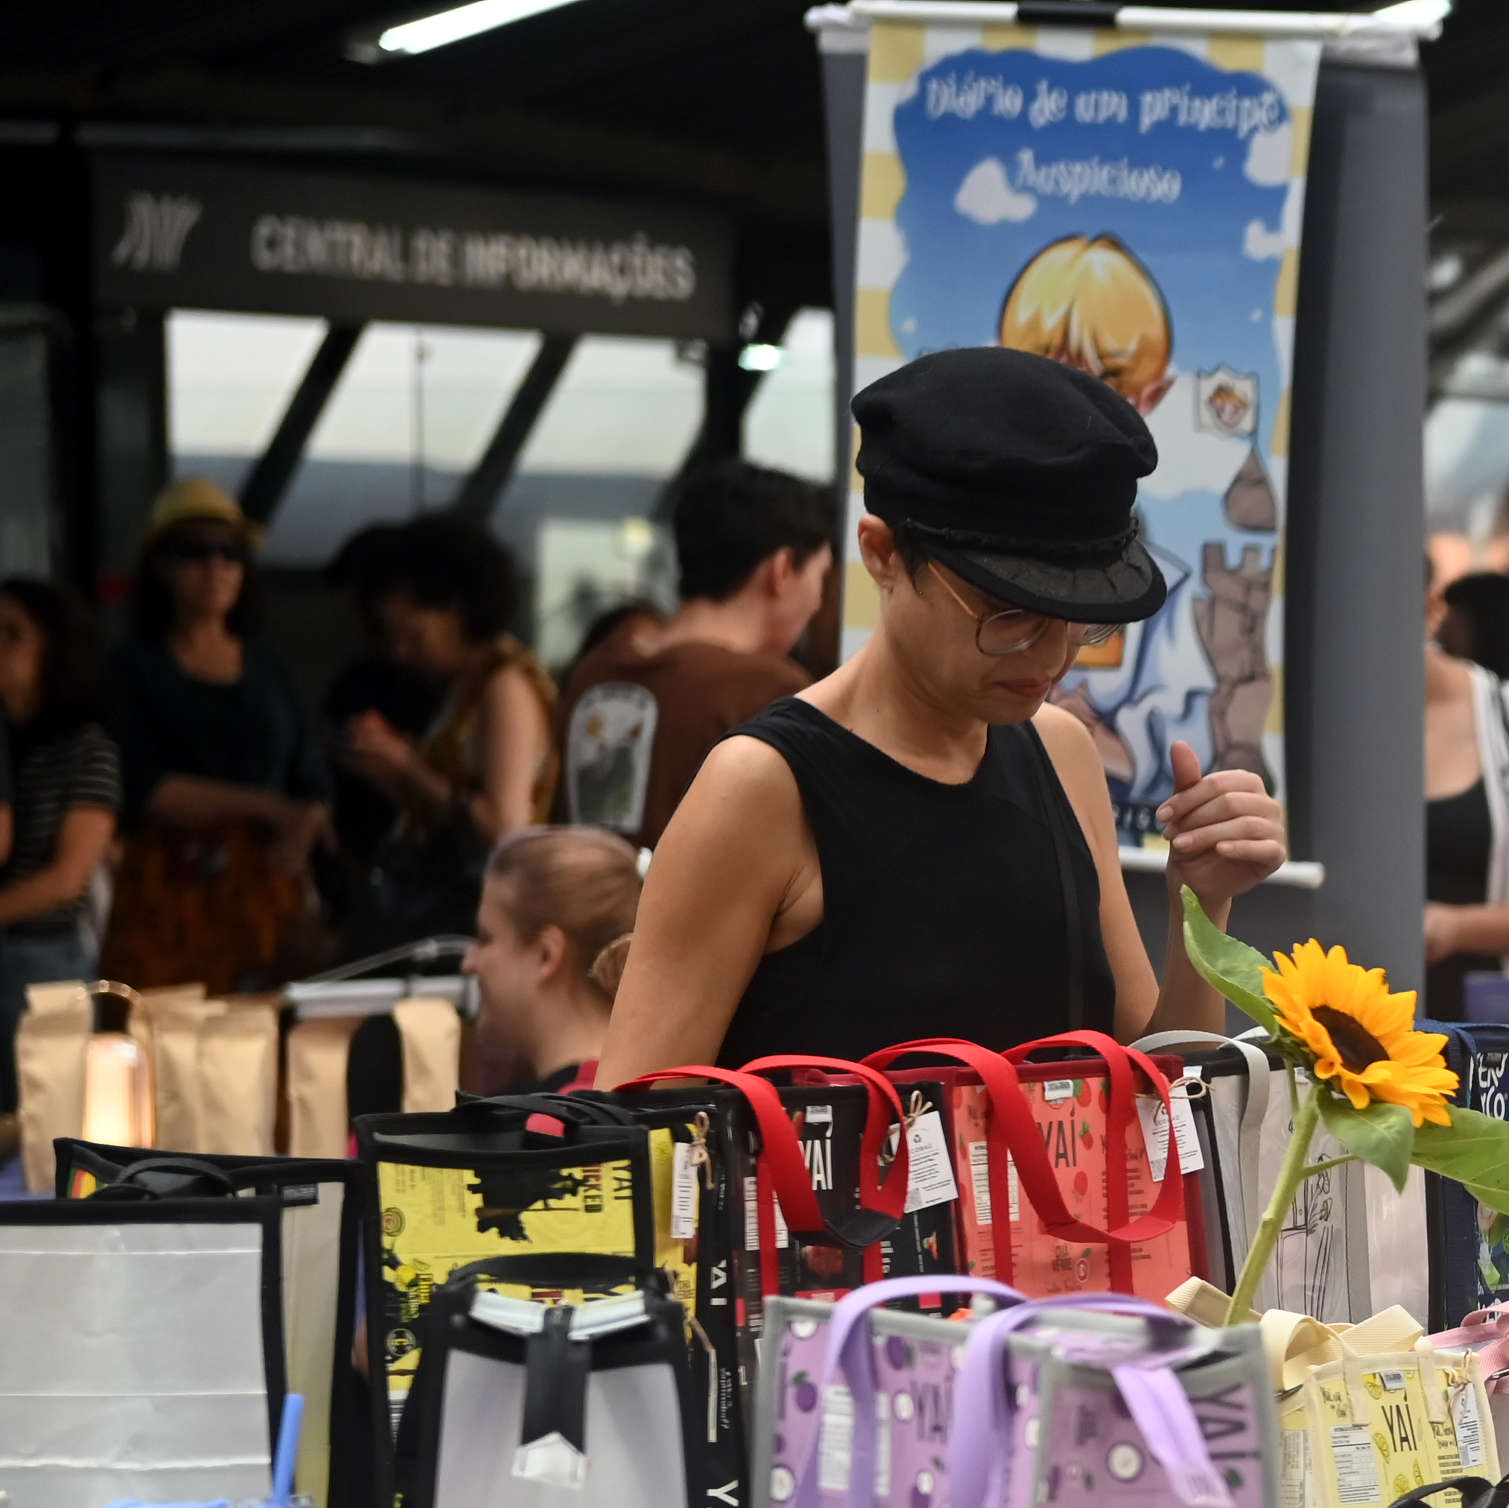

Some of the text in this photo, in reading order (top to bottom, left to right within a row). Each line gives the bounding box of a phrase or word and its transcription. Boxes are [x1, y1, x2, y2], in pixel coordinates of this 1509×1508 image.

[926, 73, 1023, 121] Diário
[1030, 80, 1068, 129] de
[1075, 87, 1129, 124] um
[1015, 148, 1183, 204] Auspicioso
[250, 215, 697, 306] CENTRAL DE INFORMAÇÕES
